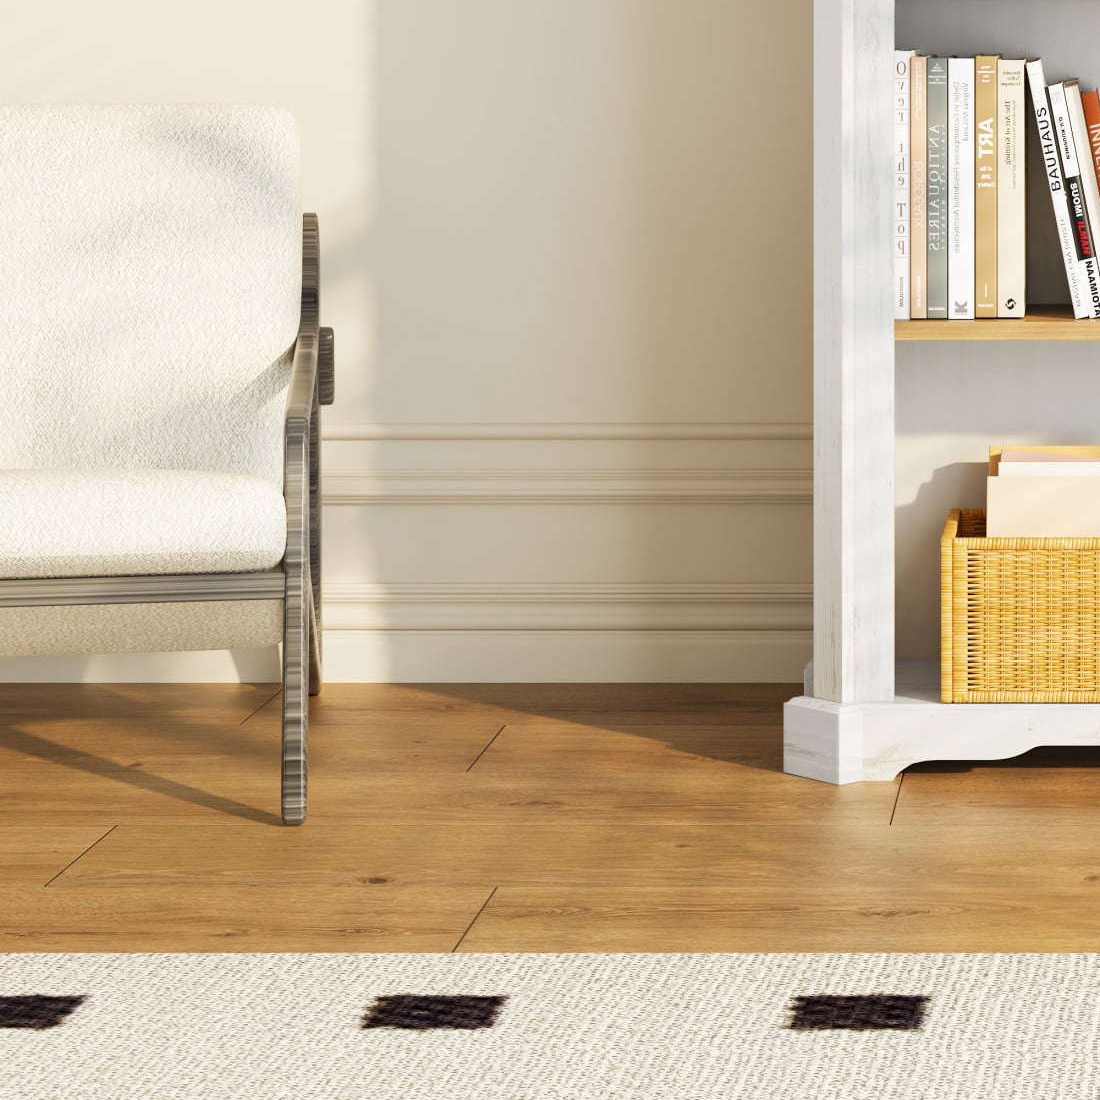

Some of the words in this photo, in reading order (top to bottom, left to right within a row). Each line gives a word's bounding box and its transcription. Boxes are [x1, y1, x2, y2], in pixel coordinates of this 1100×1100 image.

[1037, 107, 1061, 191] BAUHAUS
[1070, 182, 1084, 218] SUOMI
[1076, 221, 1091, 255] ILMAN
